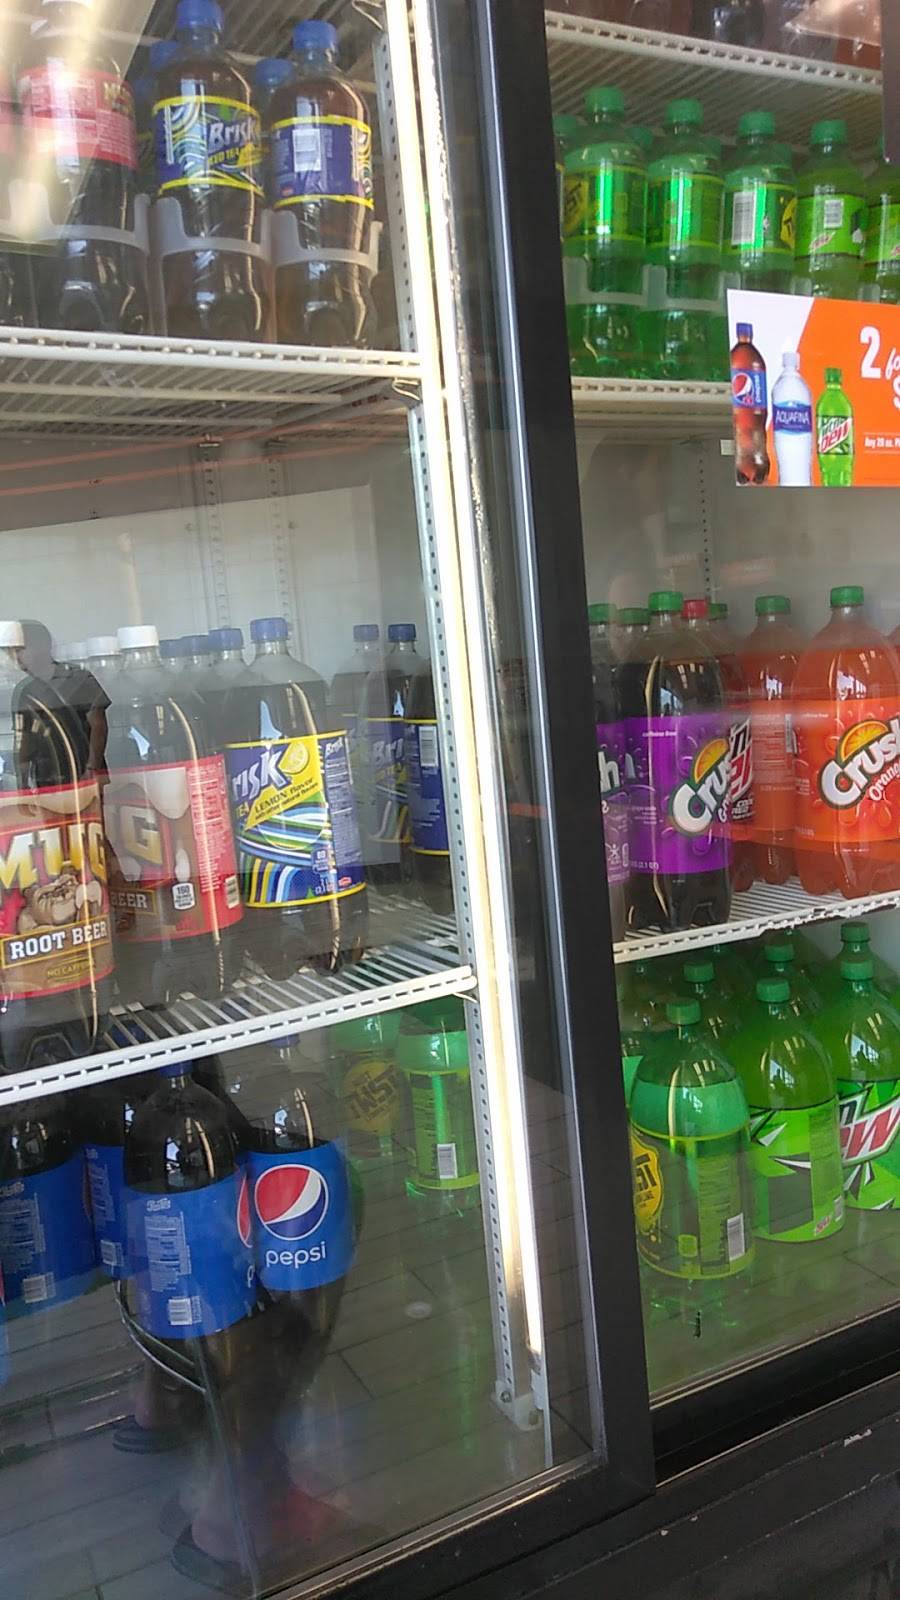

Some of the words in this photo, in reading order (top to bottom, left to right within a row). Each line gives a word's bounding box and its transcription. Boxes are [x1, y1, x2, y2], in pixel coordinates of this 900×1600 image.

[860, 326, 881, 379] 2
[775, 410, 811, 426] AQUAFINA
[254, 790, 287, 814] LEMON
[10, 931, 65, 960] ROOT
[72, 921, 107, 945] BEER
[265, 1241, 326, 1270] pepsi
